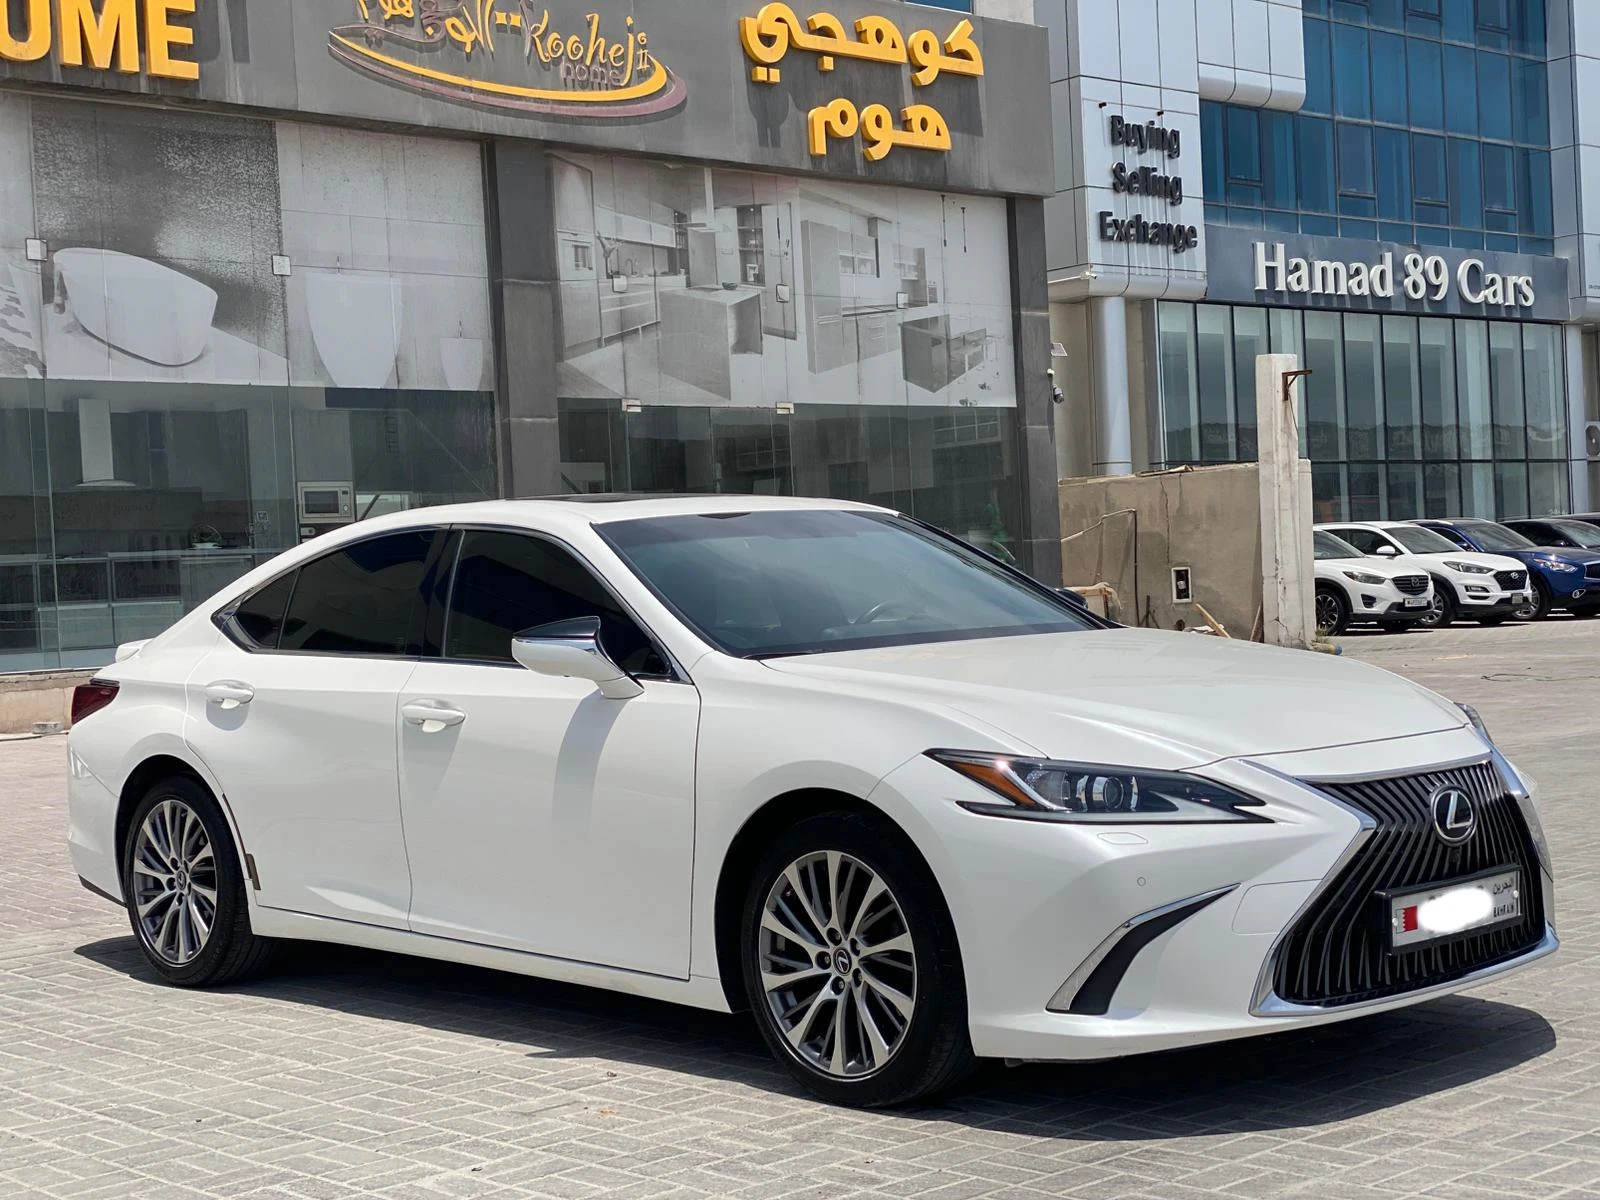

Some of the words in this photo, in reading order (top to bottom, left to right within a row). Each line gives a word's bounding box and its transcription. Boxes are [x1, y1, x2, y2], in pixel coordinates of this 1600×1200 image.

[739, 2, 985, 87] كوهجي
[560, 55, 625, 87] home
[807, 97, 952, 162] هوم
[1110, 115, 1181, 159] Buying
[1112, 162, 1183, 206] Selling
[1099, 211, 1198, 254] Exchange
[1252, 241, 1394, 299] Hamad
[1402, 252, 1450, 302] 89
[1457, 258, 1535, 307] Cars
